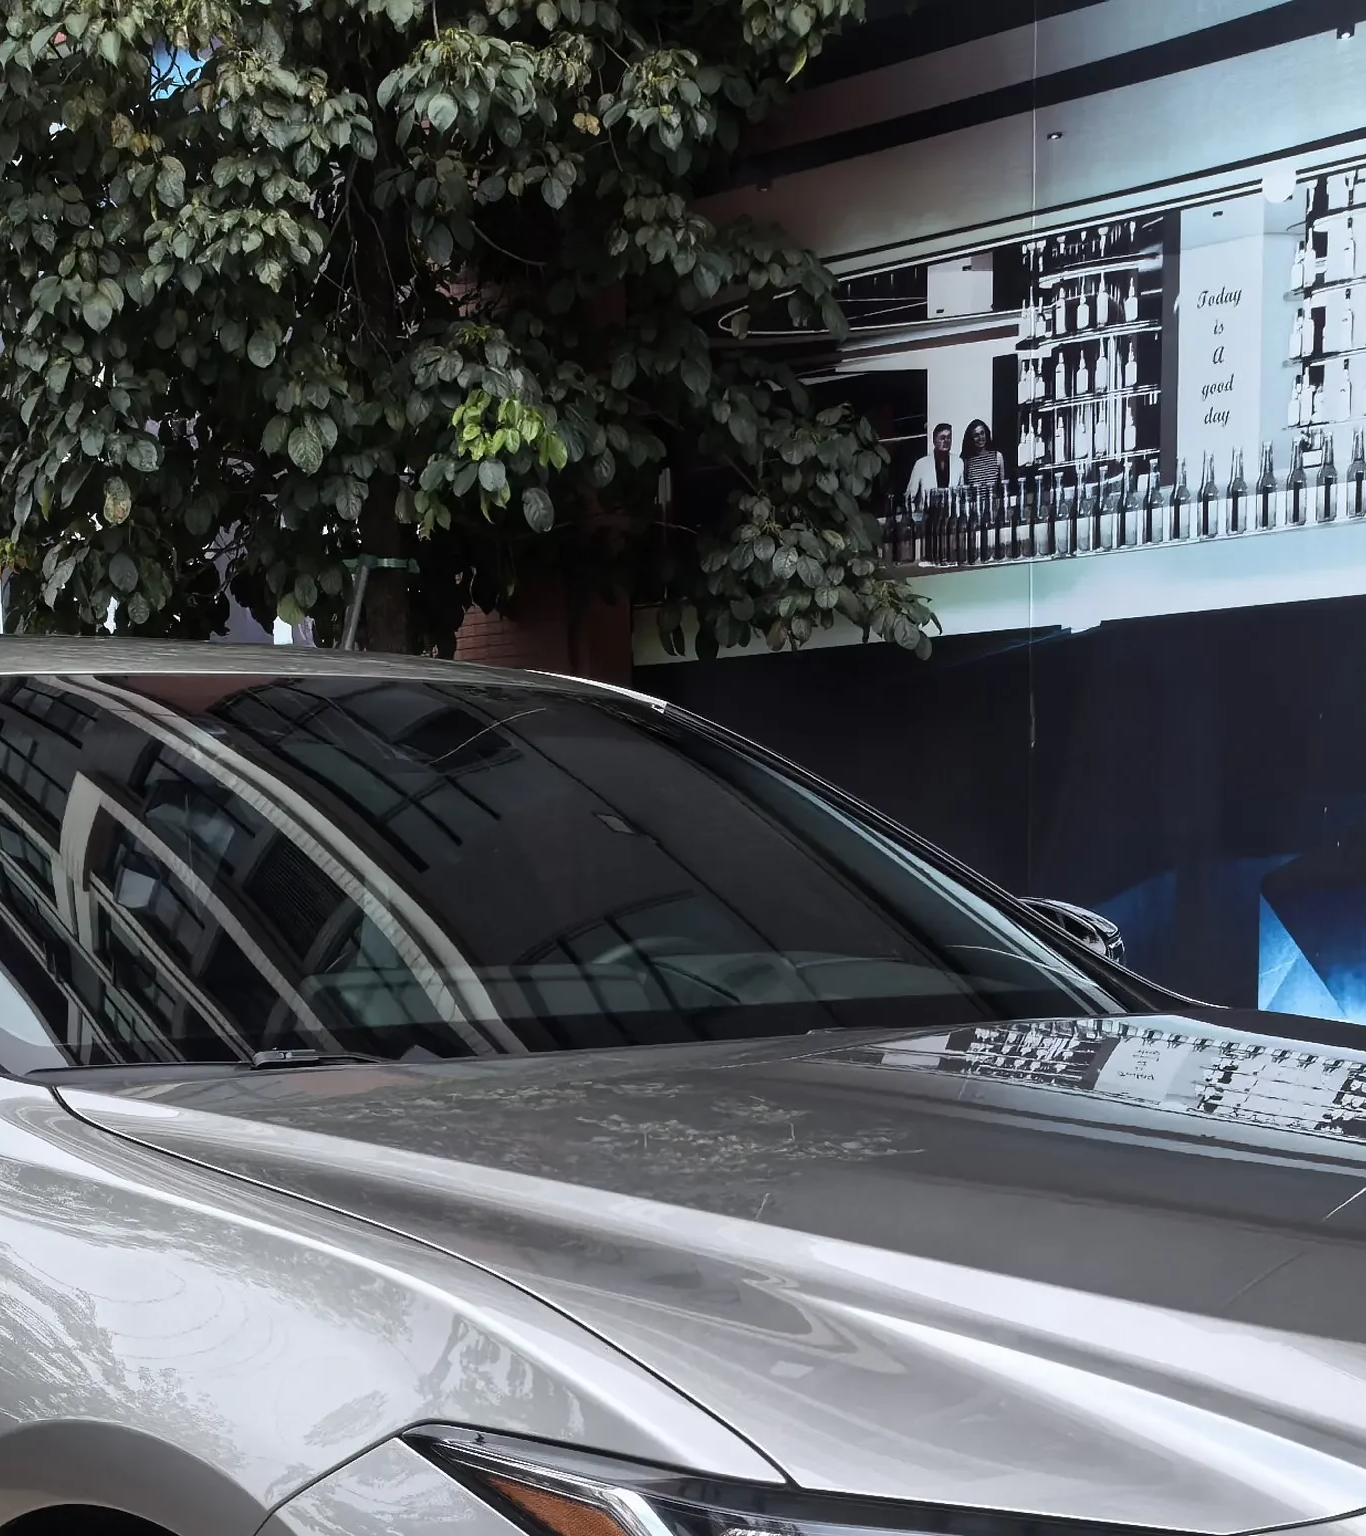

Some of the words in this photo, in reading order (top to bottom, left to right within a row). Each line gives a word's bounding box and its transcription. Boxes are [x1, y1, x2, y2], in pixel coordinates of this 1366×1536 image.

[1197, 286, 1242, 309] Today
[1213, 319, 1224, 335] is
[1201, 373, 1235, 402] good
[1204, 406, 1230, 428] day
